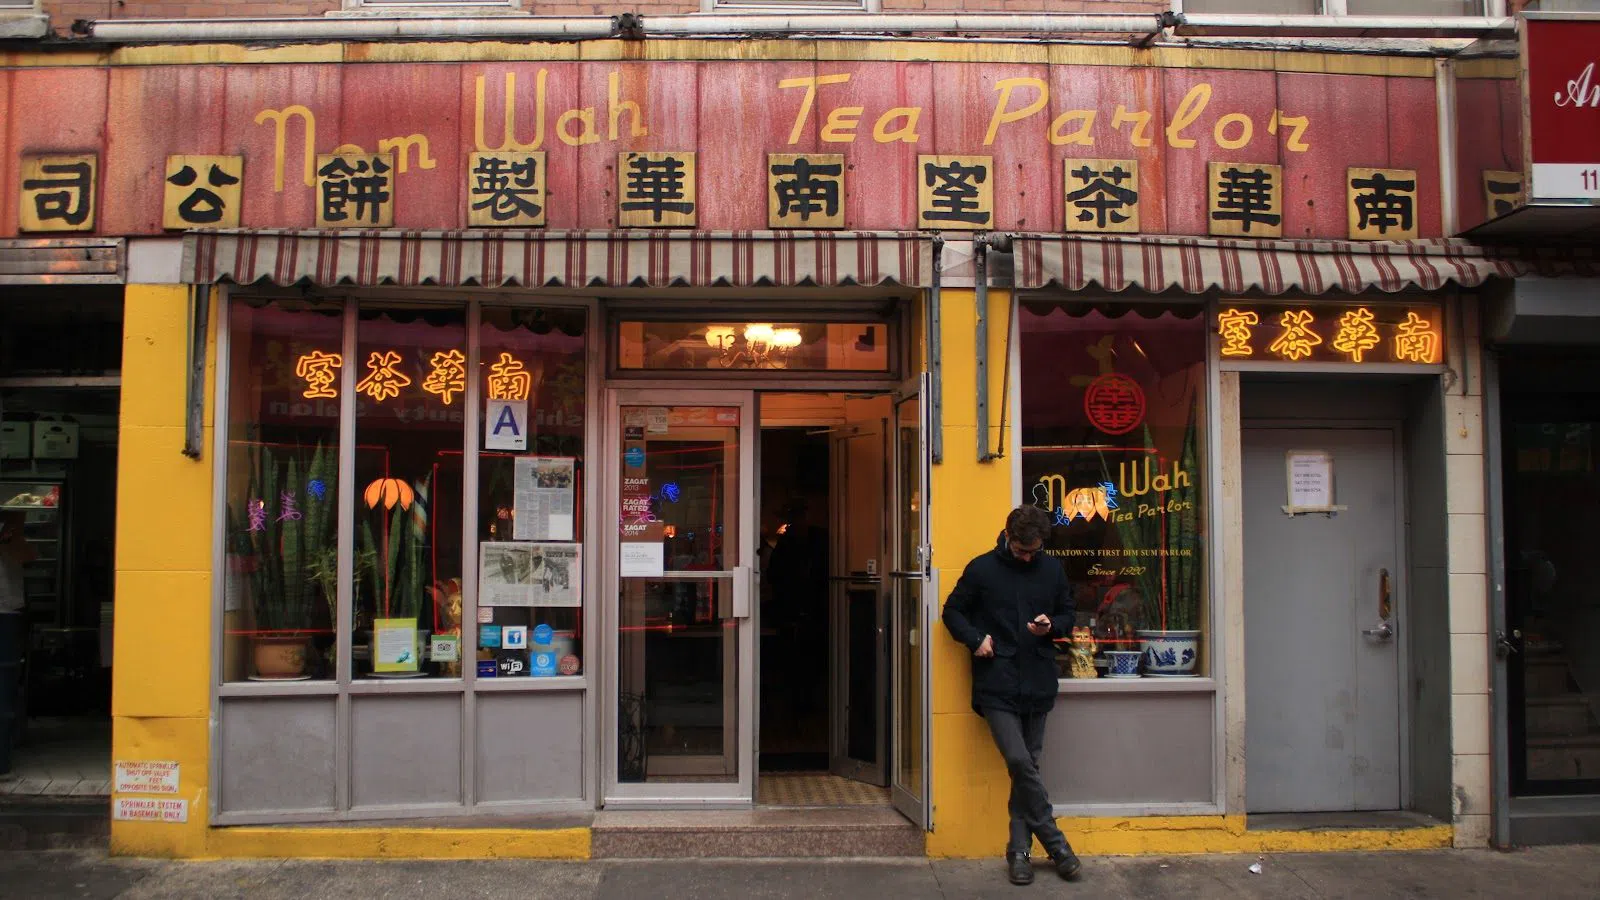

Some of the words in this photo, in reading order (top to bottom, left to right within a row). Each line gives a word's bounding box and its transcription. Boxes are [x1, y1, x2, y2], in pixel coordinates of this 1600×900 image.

[254, 105, 436, 192] Nm
[475, 69, 648, 152] Wah
[778, 73, 921, 145] Tea
[984, 77, 1310, 152] Parlor
[492, 405, 520, 436] A
[1119, 456, 1191, 498] Wah
[1109, 508, 1134, 523] Tea
[1138, 500, 1192, 518] Parlor
[1045, 549, 1095, 557] HINATOWN'S
[1097, 549, 1120, 557] FIRST
[1123, 549, 1139, 557] DIM
[1140, 549, 1158, 557] SUM
[1087, 563, 1117, 576] Since
[1119, 566, 1147, 576] 1920
[120, 800, 155, 809] SPRINKLER
[158, 801, 182, 810] SYSTEM
[164, 811, 181, 819] ONLY
